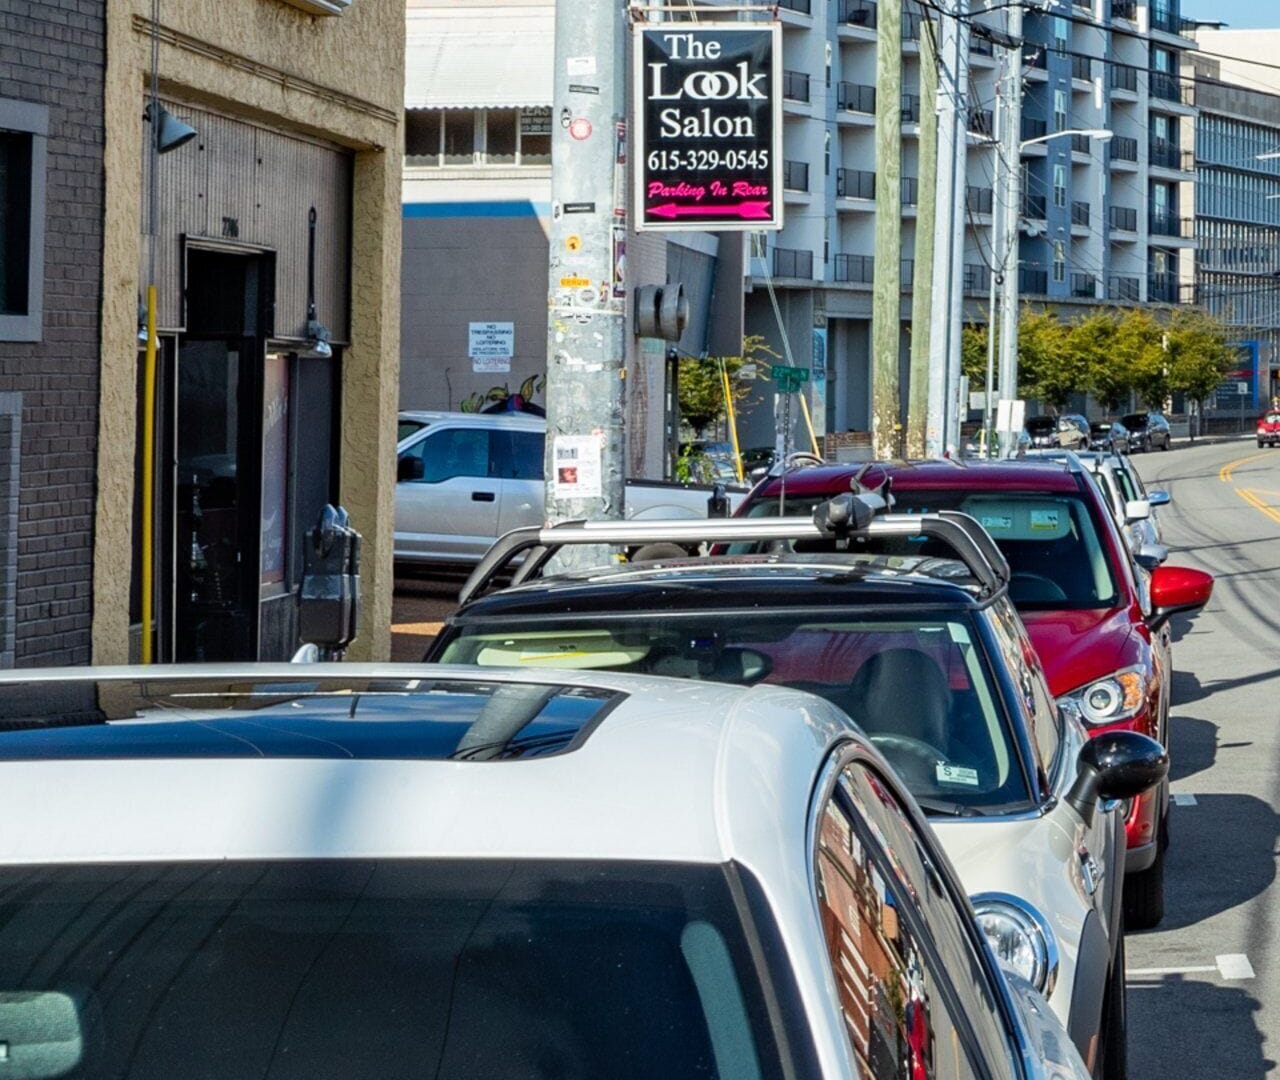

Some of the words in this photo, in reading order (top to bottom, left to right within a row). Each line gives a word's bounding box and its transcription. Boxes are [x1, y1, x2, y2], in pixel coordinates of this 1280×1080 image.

[664, 34, 721, 59] The
[648, 62, 768, 100] Look
[660, 108, 755, 138] Salon
[648, 150, 769, 171] 615-329-0545
[648, 181, 706, 201] Parking
[710, 181, 727, 197] In
[732, 181, 768, 197] Rear
